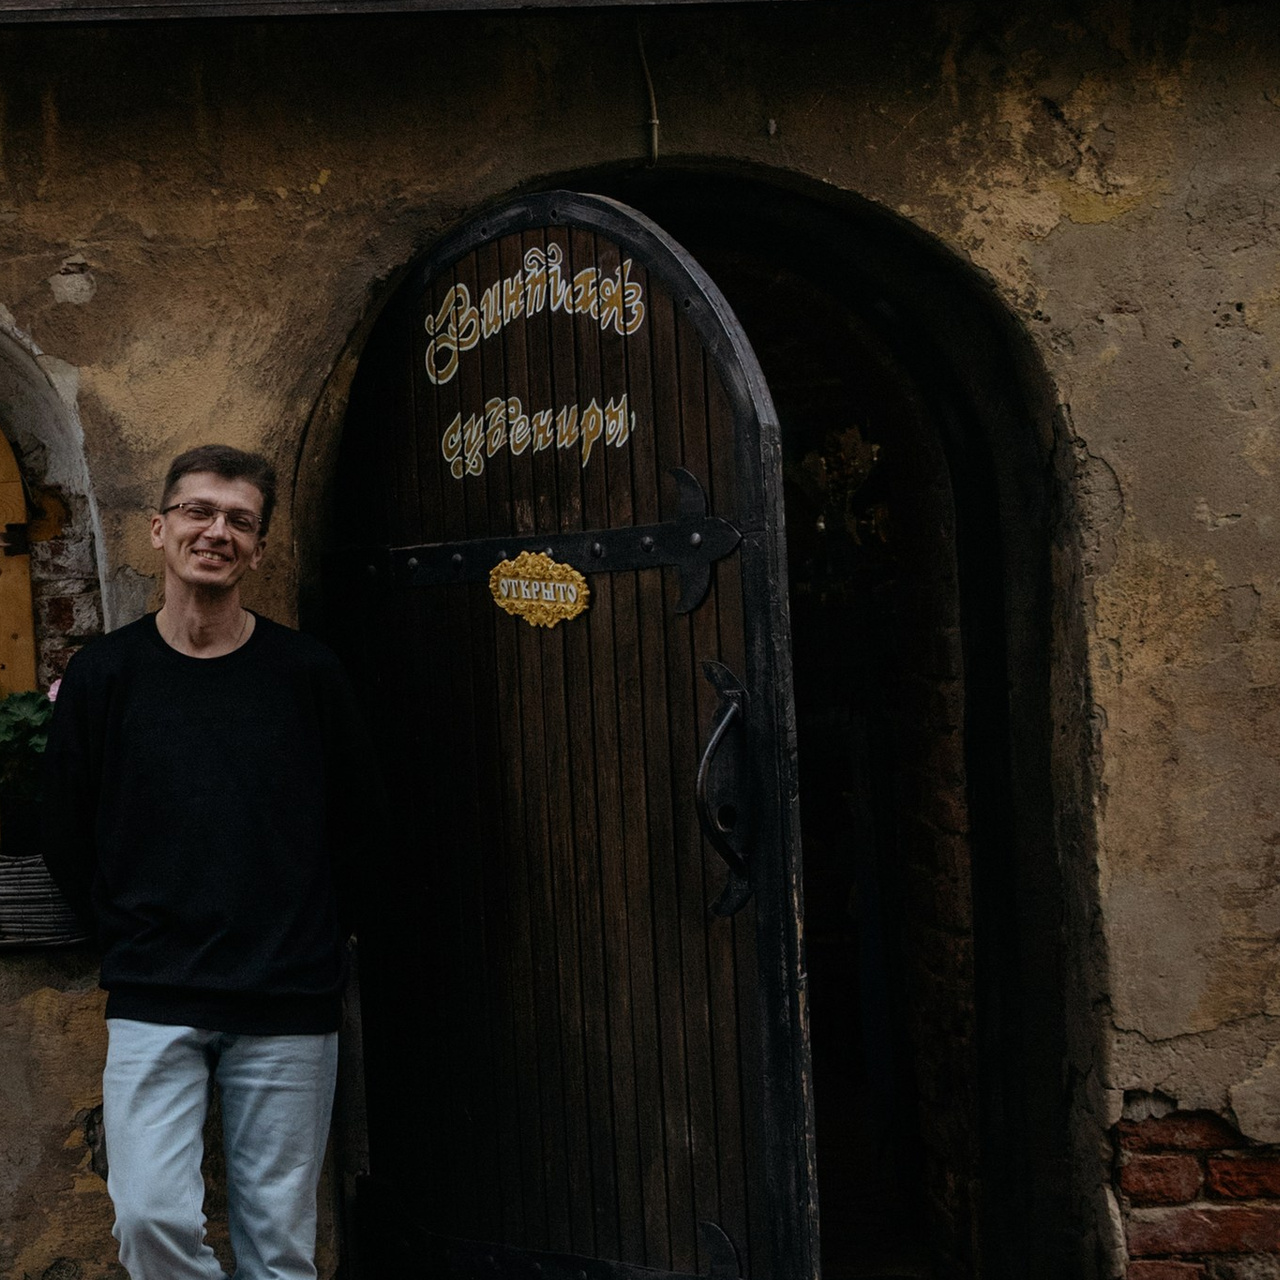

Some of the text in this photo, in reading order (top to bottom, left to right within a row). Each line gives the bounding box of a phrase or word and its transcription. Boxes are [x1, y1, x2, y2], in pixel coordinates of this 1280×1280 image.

[425, 242, 645, 385] Винтаж
[441, 393, 636, 479] сувениры
[499, 578, 578, 604] ОТКРЫТО
